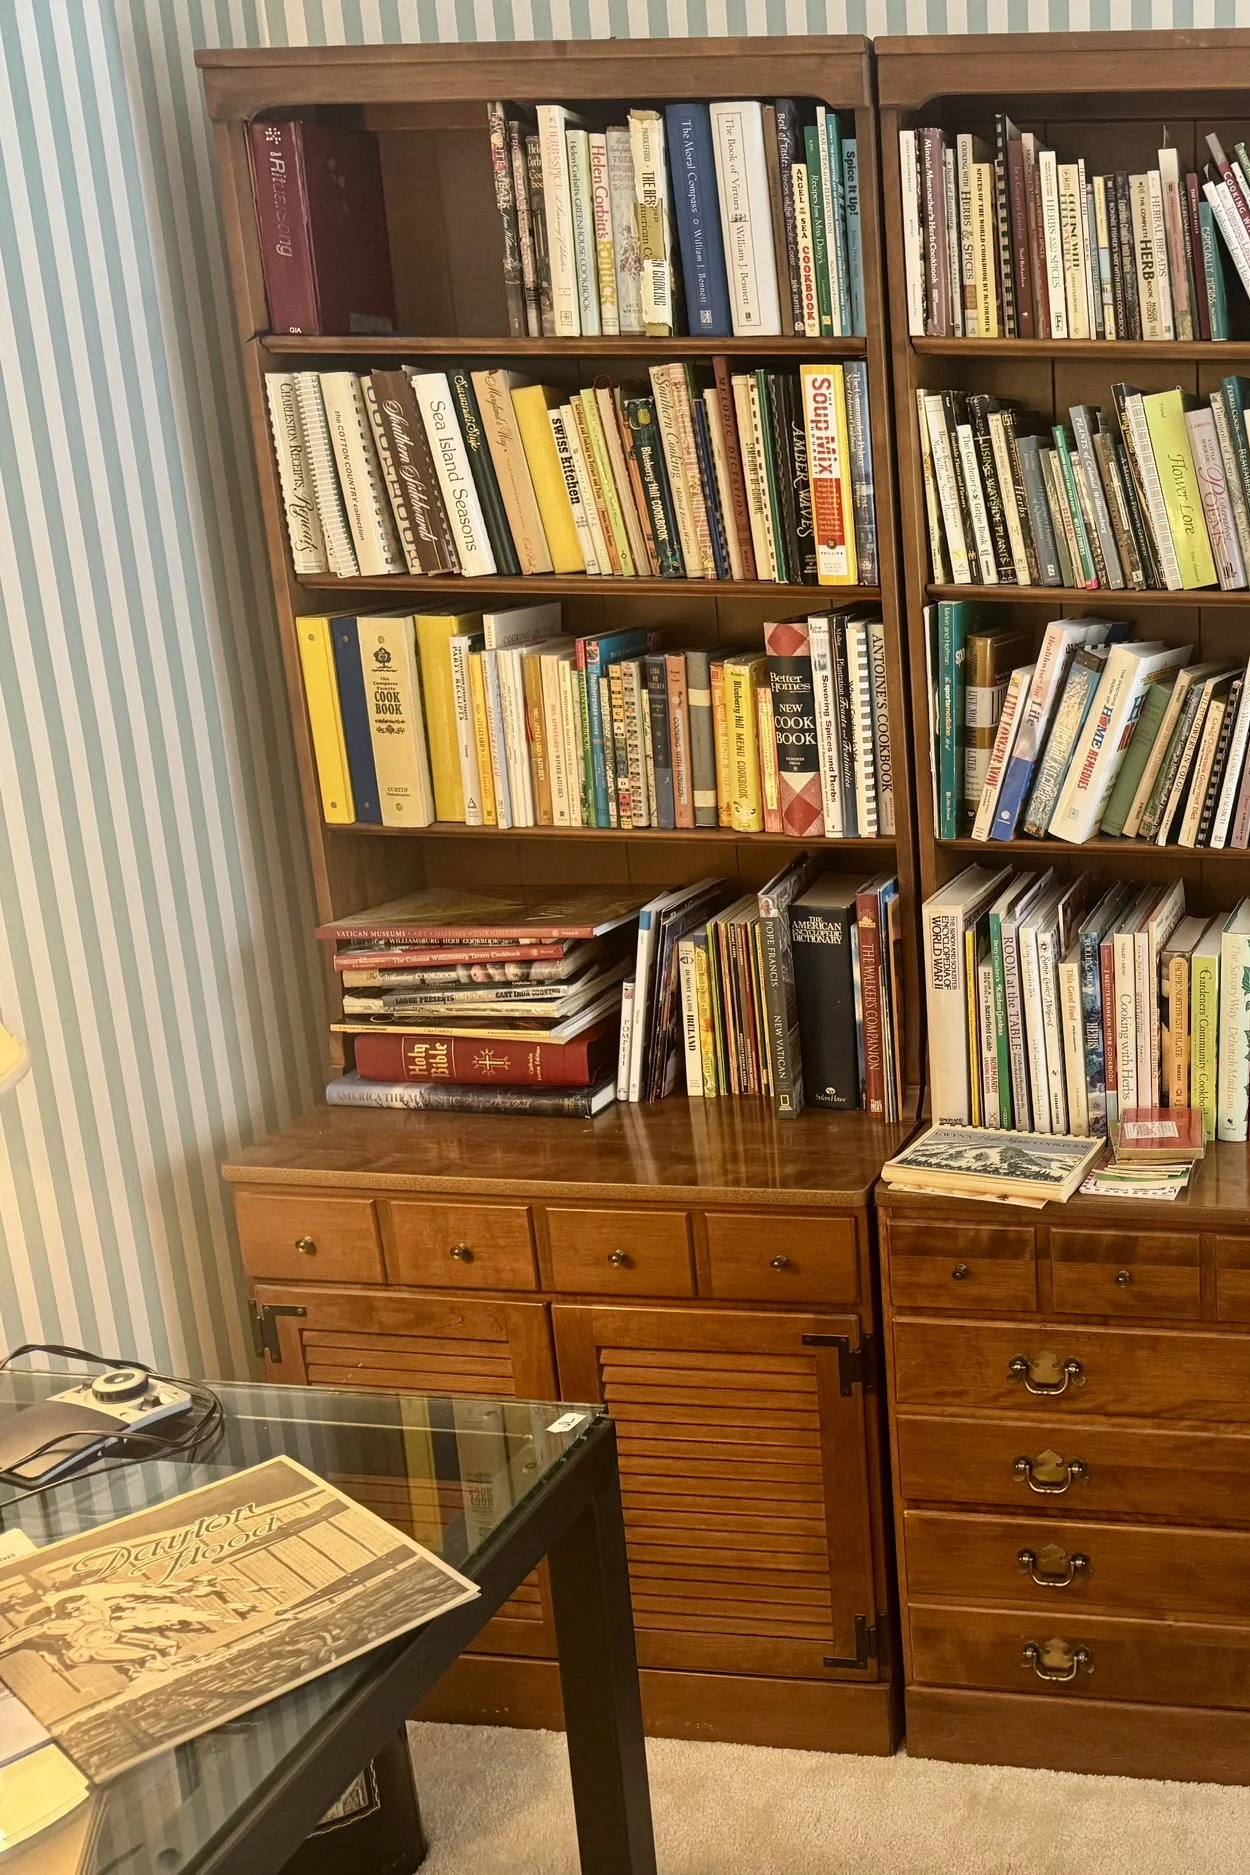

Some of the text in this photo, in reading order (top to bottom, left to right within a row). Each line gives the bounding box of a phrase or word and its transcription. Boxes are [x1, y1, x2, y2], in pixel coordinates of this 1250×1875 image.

[681, 120, 698, 213] The Moral Compass
[725, 118, 740, 211] The Book of Virtues
[845, 151, 858, 216] Spice It Up!
[1223, 171, 1246, 214] COOKING
[591, 145, 615, 305] Helen Corbitt's POTLUCK
[736, 226, 746, 261] William
[924, 139, 933, 169] Minnie
[930, 243, 939, 283] Cookbook
[694, 230, 702, 261] William
[698, 273, 707, 303] Bennett
[740, 272, 751, 305] Bennett
[551, 418, 582, 505] swiss kitchen
[811, 377, 837, 475] Soup Mix
[337, 425, 349, 460] COTTON
[344, 462, 358, 503] COUNTRY
[353, 504, 365, 541] collection
[429, 400, 477, 552] Sea Island Seasons
[1168, 454, 1196, 535] Flower Lore
[374, 691, 401, 703] COOK
[375, 703, 403, 716] BOOK
[770, 673, 802, 682] Better
[780, 704, 803, 712] NEW
[872, 634, 892, 793] ANTOINE'S COOKBOOK
[733, 681, 747, 799] Blueberry Hill MENU COOKBOOK
[775, 716, 815, 729] COOK
[776, 732, 816, 745] BOOK
[1078, 706, 1114, 790] HOME REMEDIES
[931, 916, 941, 957] WORLD
[933, 958, 943, 981] WAR
[863, 944, 879, 1070] THE WALKER'S COMPANION
[1002, 937, 1021, 1051] ROOM at the TABLE
[410, 1044, 429, 1076] Holy
[432, 1042, 449, 1077] Bible
[1119, 993, 1133, 1100] Cooking with Herbs
[72, 1502, 255, 1580] Dayton
